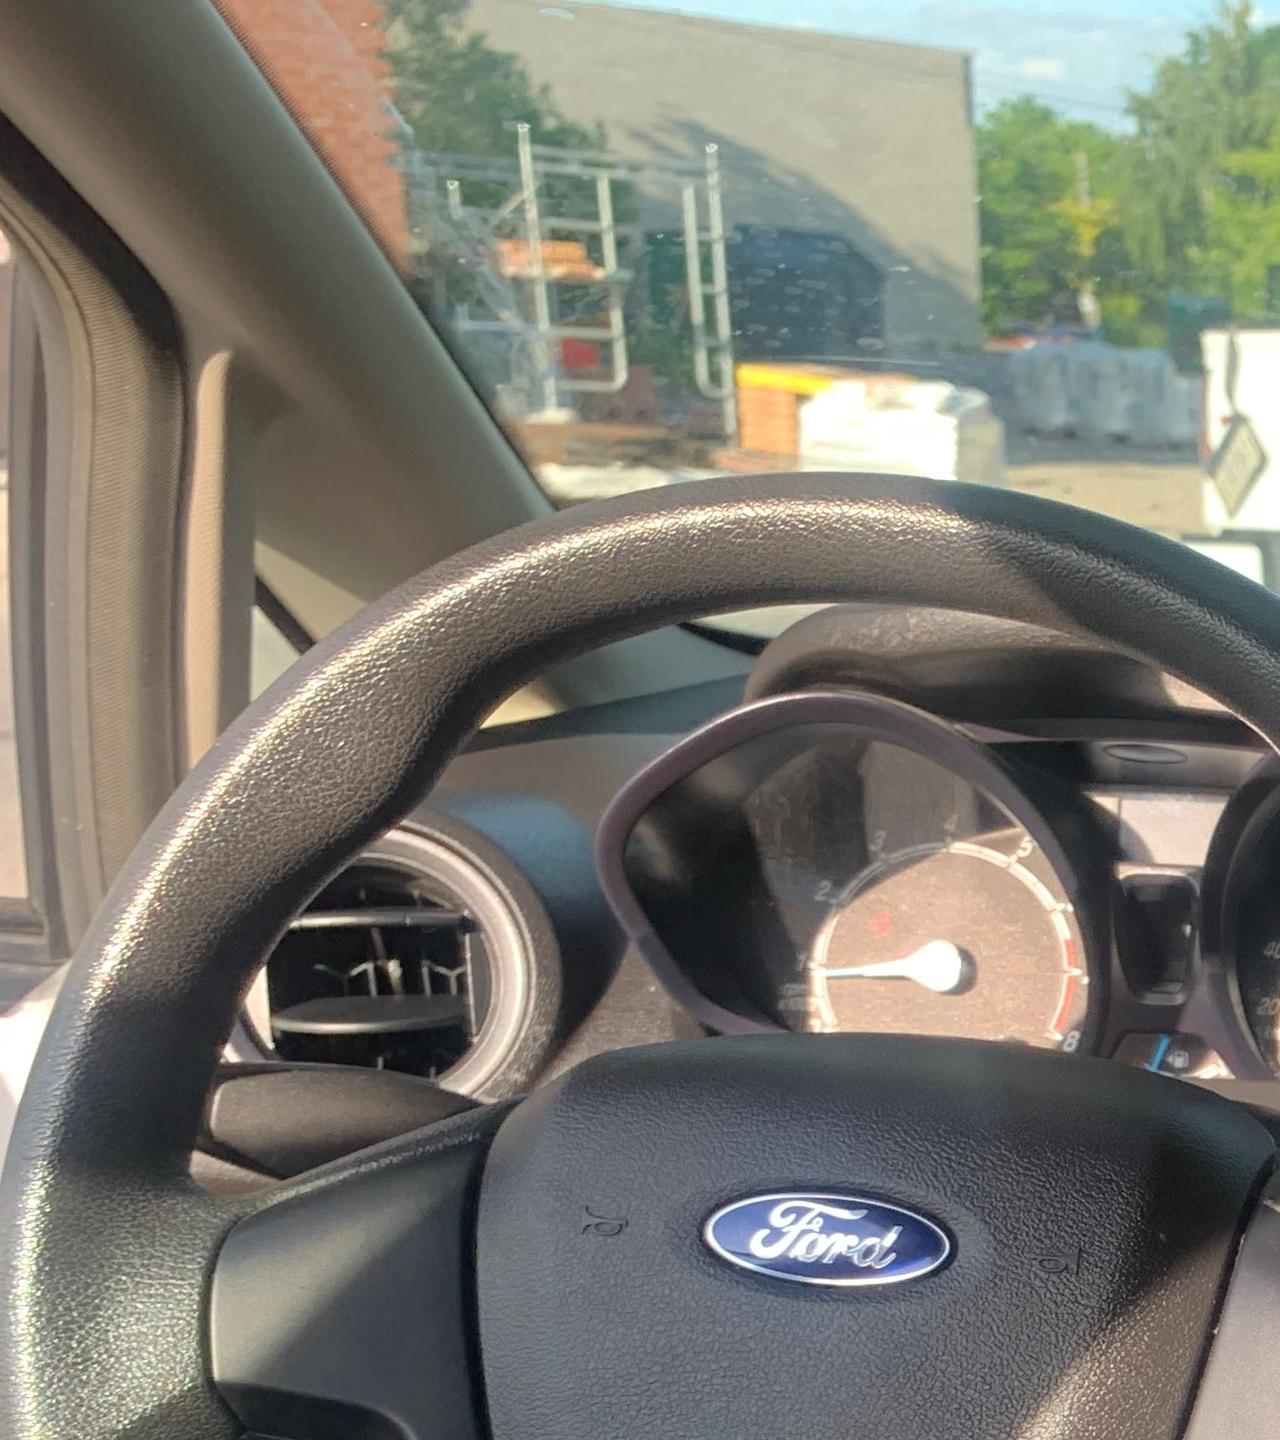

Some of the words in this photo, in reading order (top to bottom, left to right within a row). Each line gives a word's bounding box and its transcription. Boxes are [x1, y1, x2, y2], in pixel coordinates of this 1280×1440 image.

[1017, 834, 1035, 858] 5
[813, 879, 833, 902] 2
[1063, 1029, 1081, 1052] 8
[750, 1200, 904, 1269] Ford
